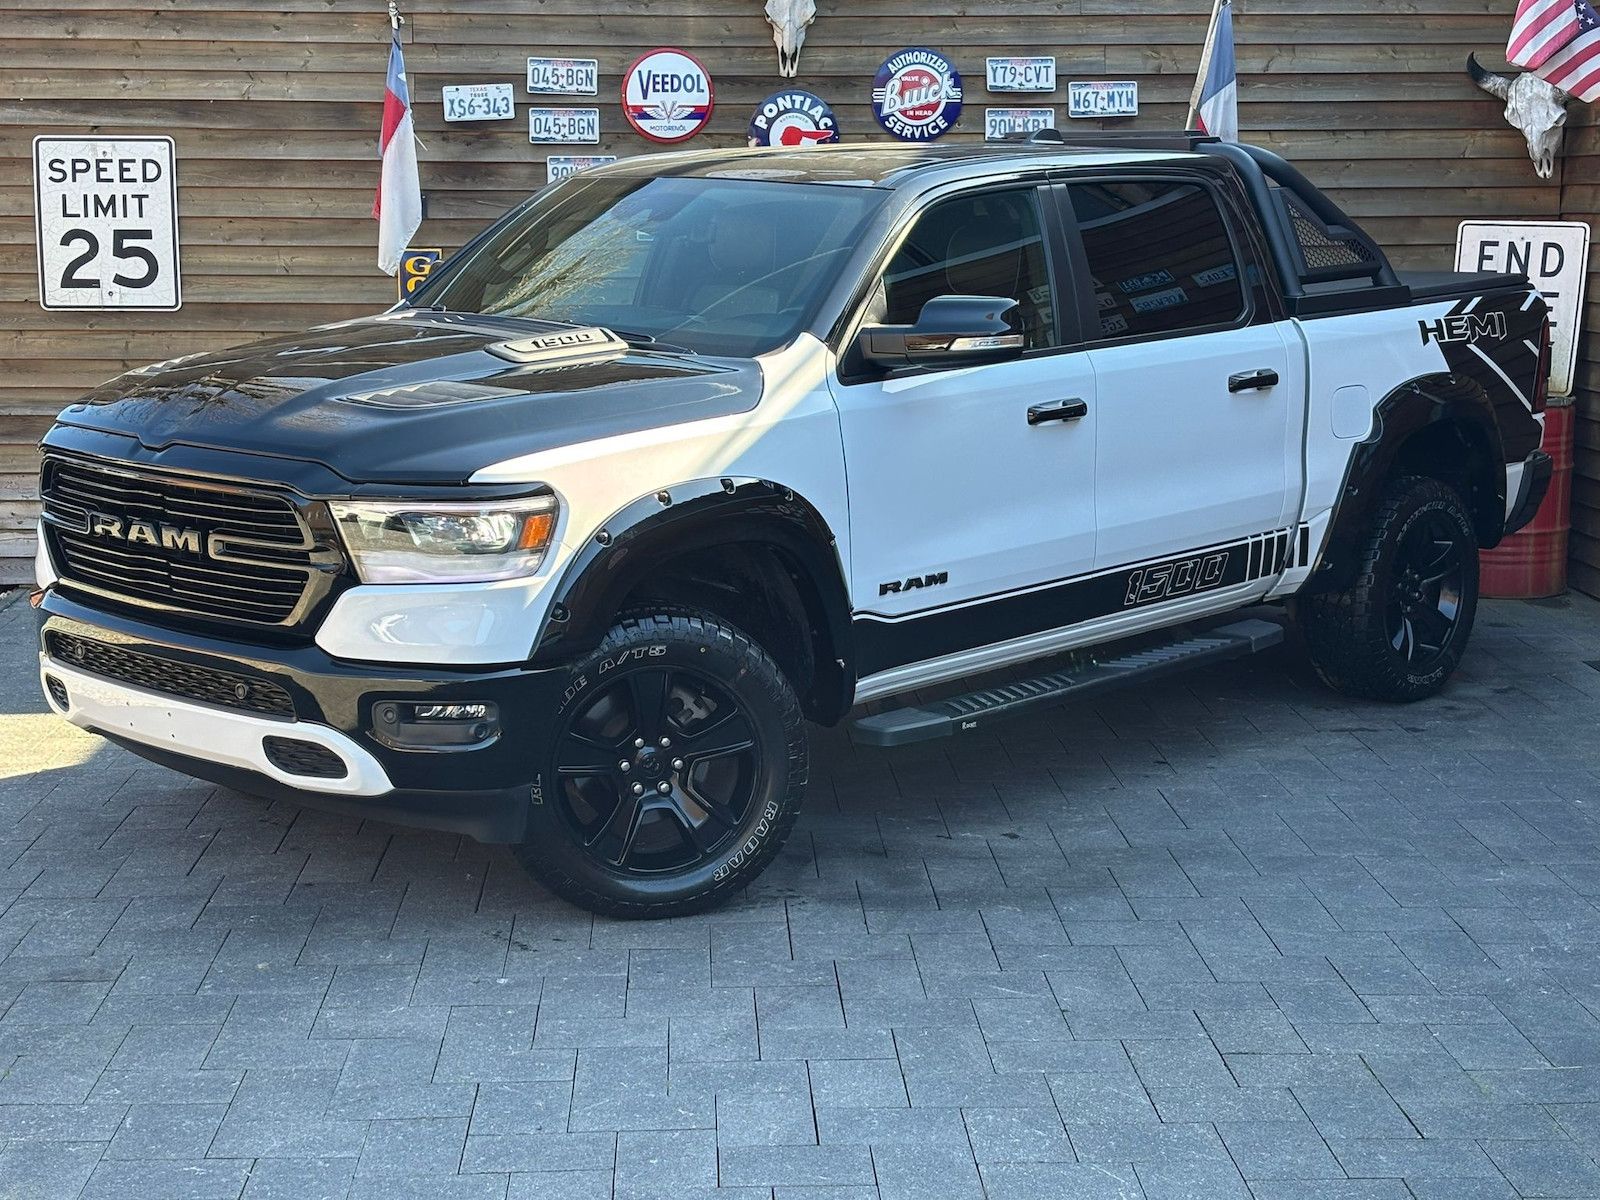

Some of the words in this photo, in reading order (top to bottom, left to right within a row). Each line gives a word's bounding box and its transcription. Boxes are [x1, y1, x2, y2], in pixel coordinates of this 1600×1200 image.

[887, 51, 948, 74] AUTHORIZED
[638, 70, 704, 100] VEEDOL
[881, 71, 954, 116] Buick
[754, 95, 833, 130] PONTIAC
[885, 116, 948, 139] SERVICE
[48, 158, 162, 183] SPEED
[62, 194, 149, 218] LIMIT
[59, 228, 159, 288] 25
[1477, 240, 1564, 277] END
[531, 333, 593, 349] 1500
[1418, 311, 1508, 346] HEMI
[92, 511, 202, 553] RAM
[879, 571, 948, 596] RAM
[1124, 552, 1229, 605] 1500
[712, 800, 779, 882] RADAR
